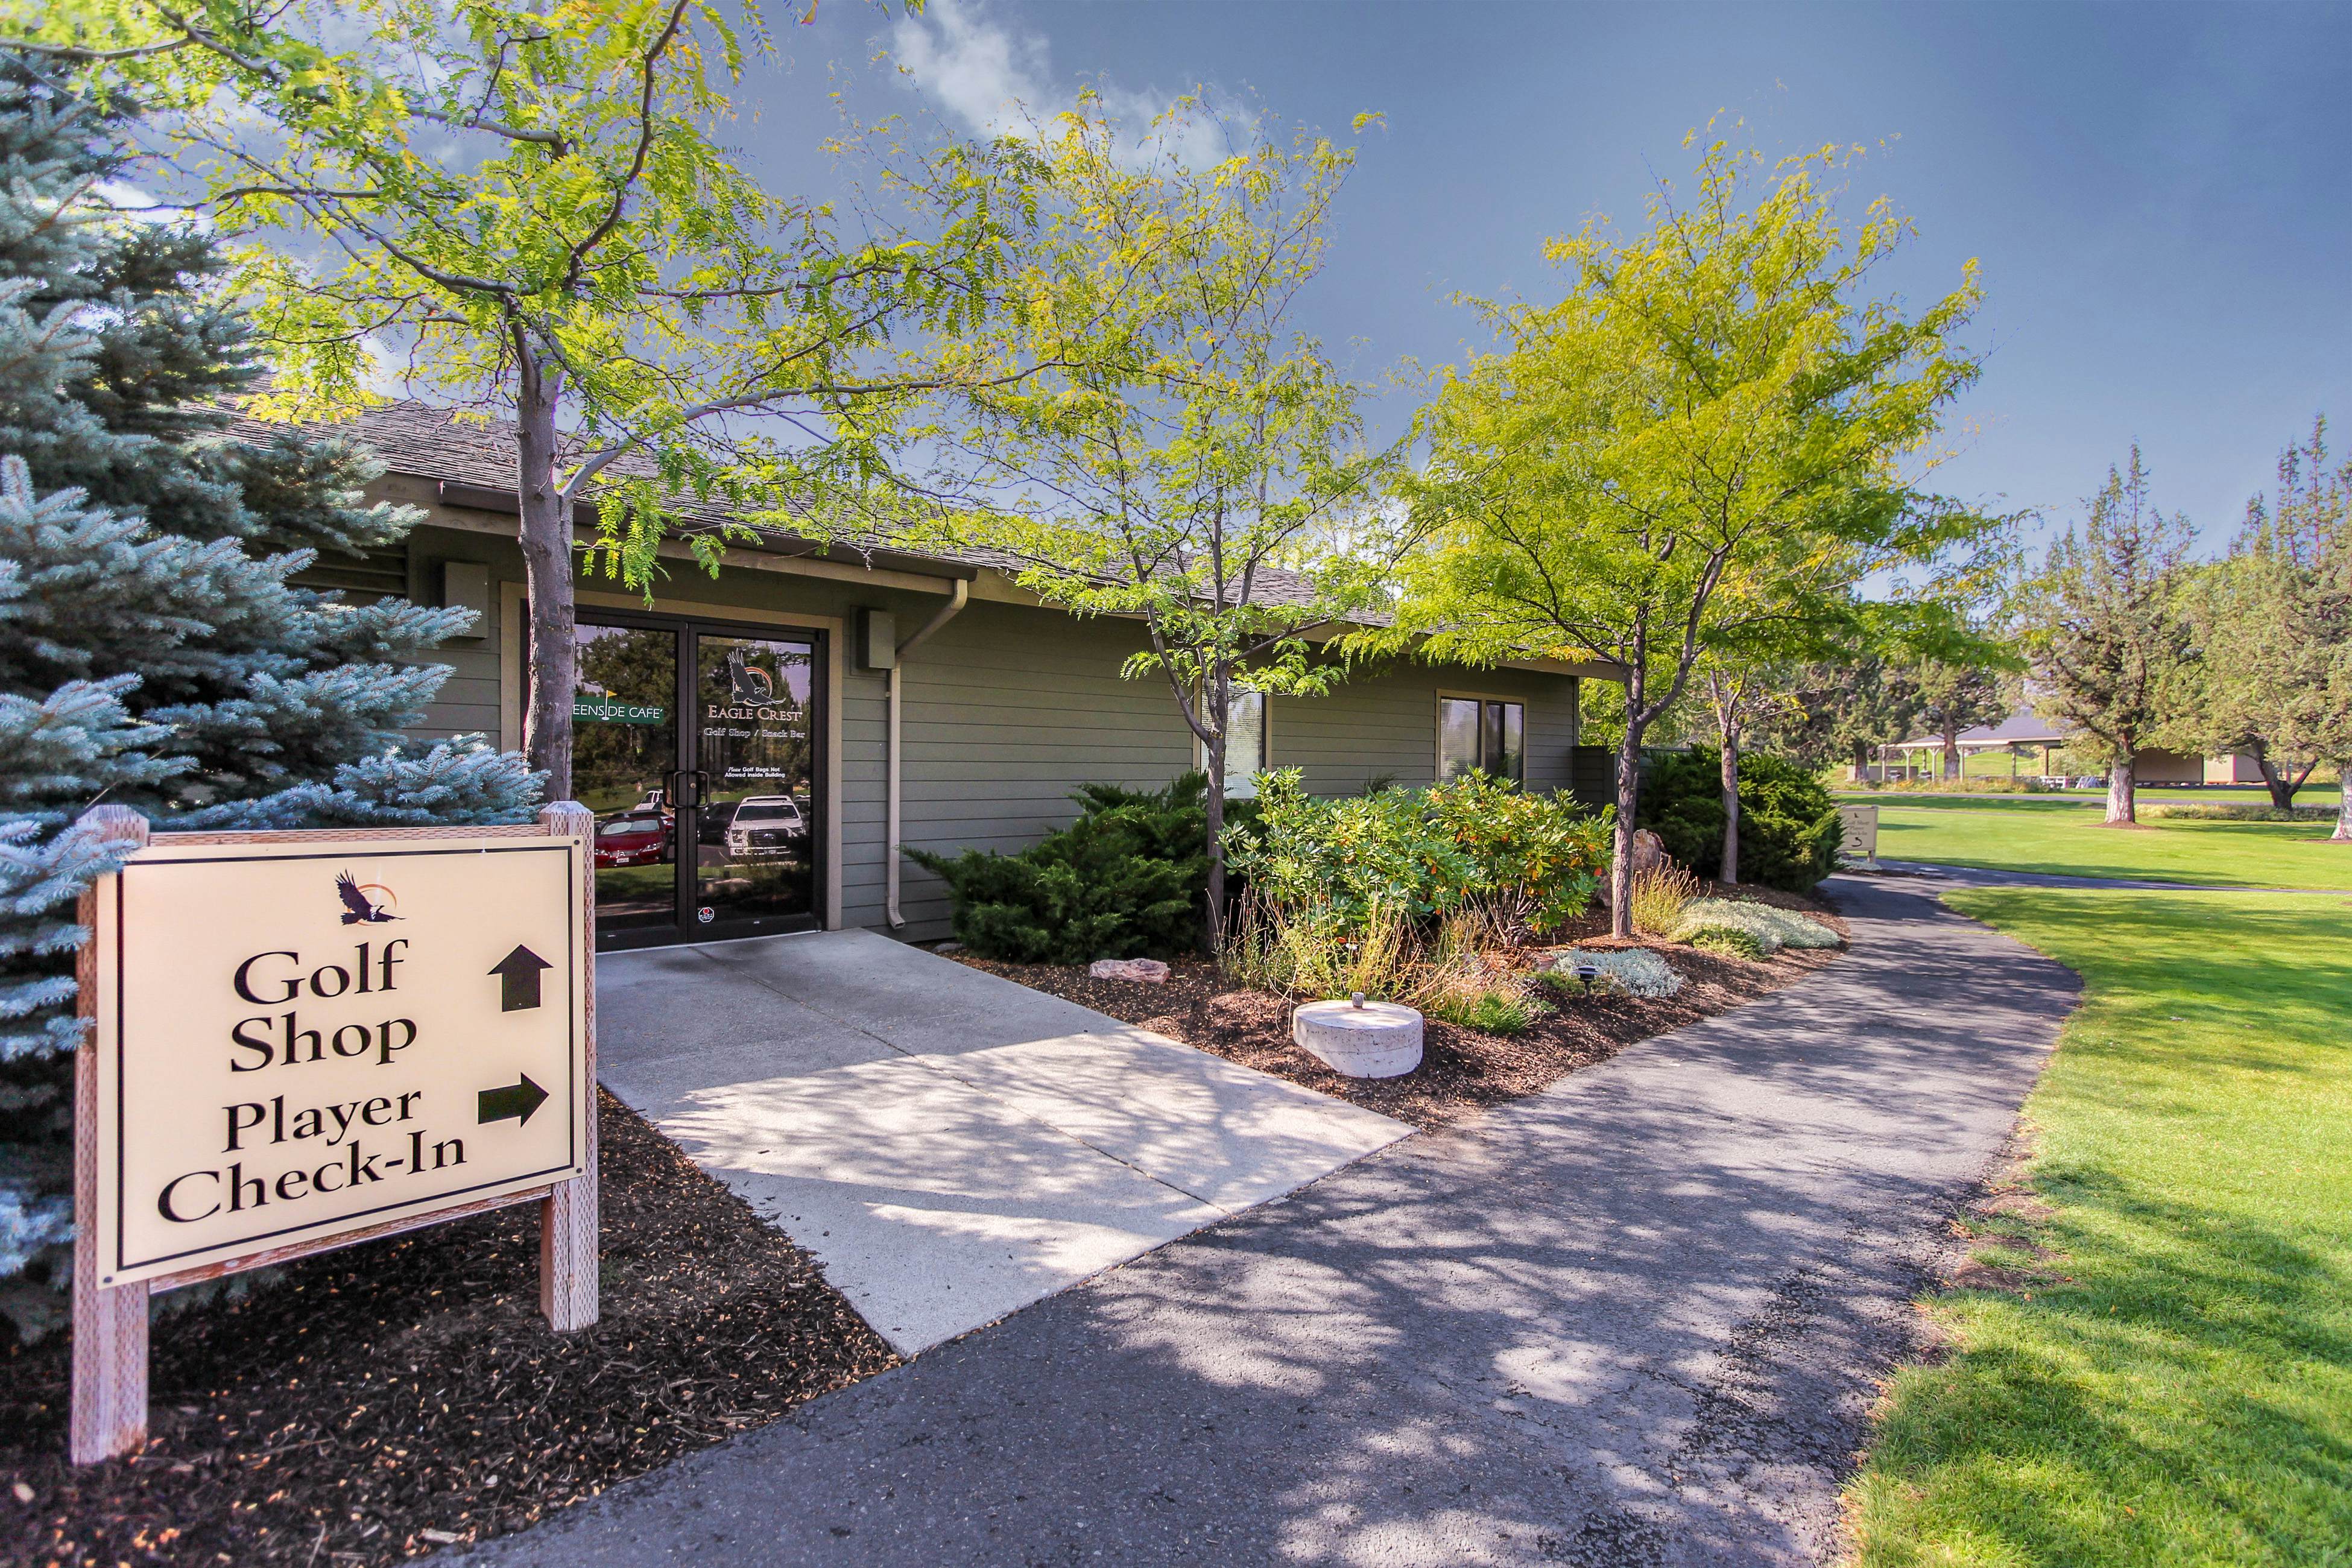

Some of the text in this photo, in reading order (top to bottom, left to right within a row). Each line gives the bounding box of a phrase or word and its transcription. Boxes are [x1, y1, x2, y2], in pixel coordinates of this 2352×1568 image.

[573, 704, 625, 716] EENSIDE
[708, 705, 803, 721] EAGLE CREST
[729, 729, 751, 738] Shop
[234, 939, 408, 1005] Golf
[230, 1011, 417, 1072] Shop
[221, 1090, 422, 1153] Player
[157, 1130, 467, 1223] Check-In
